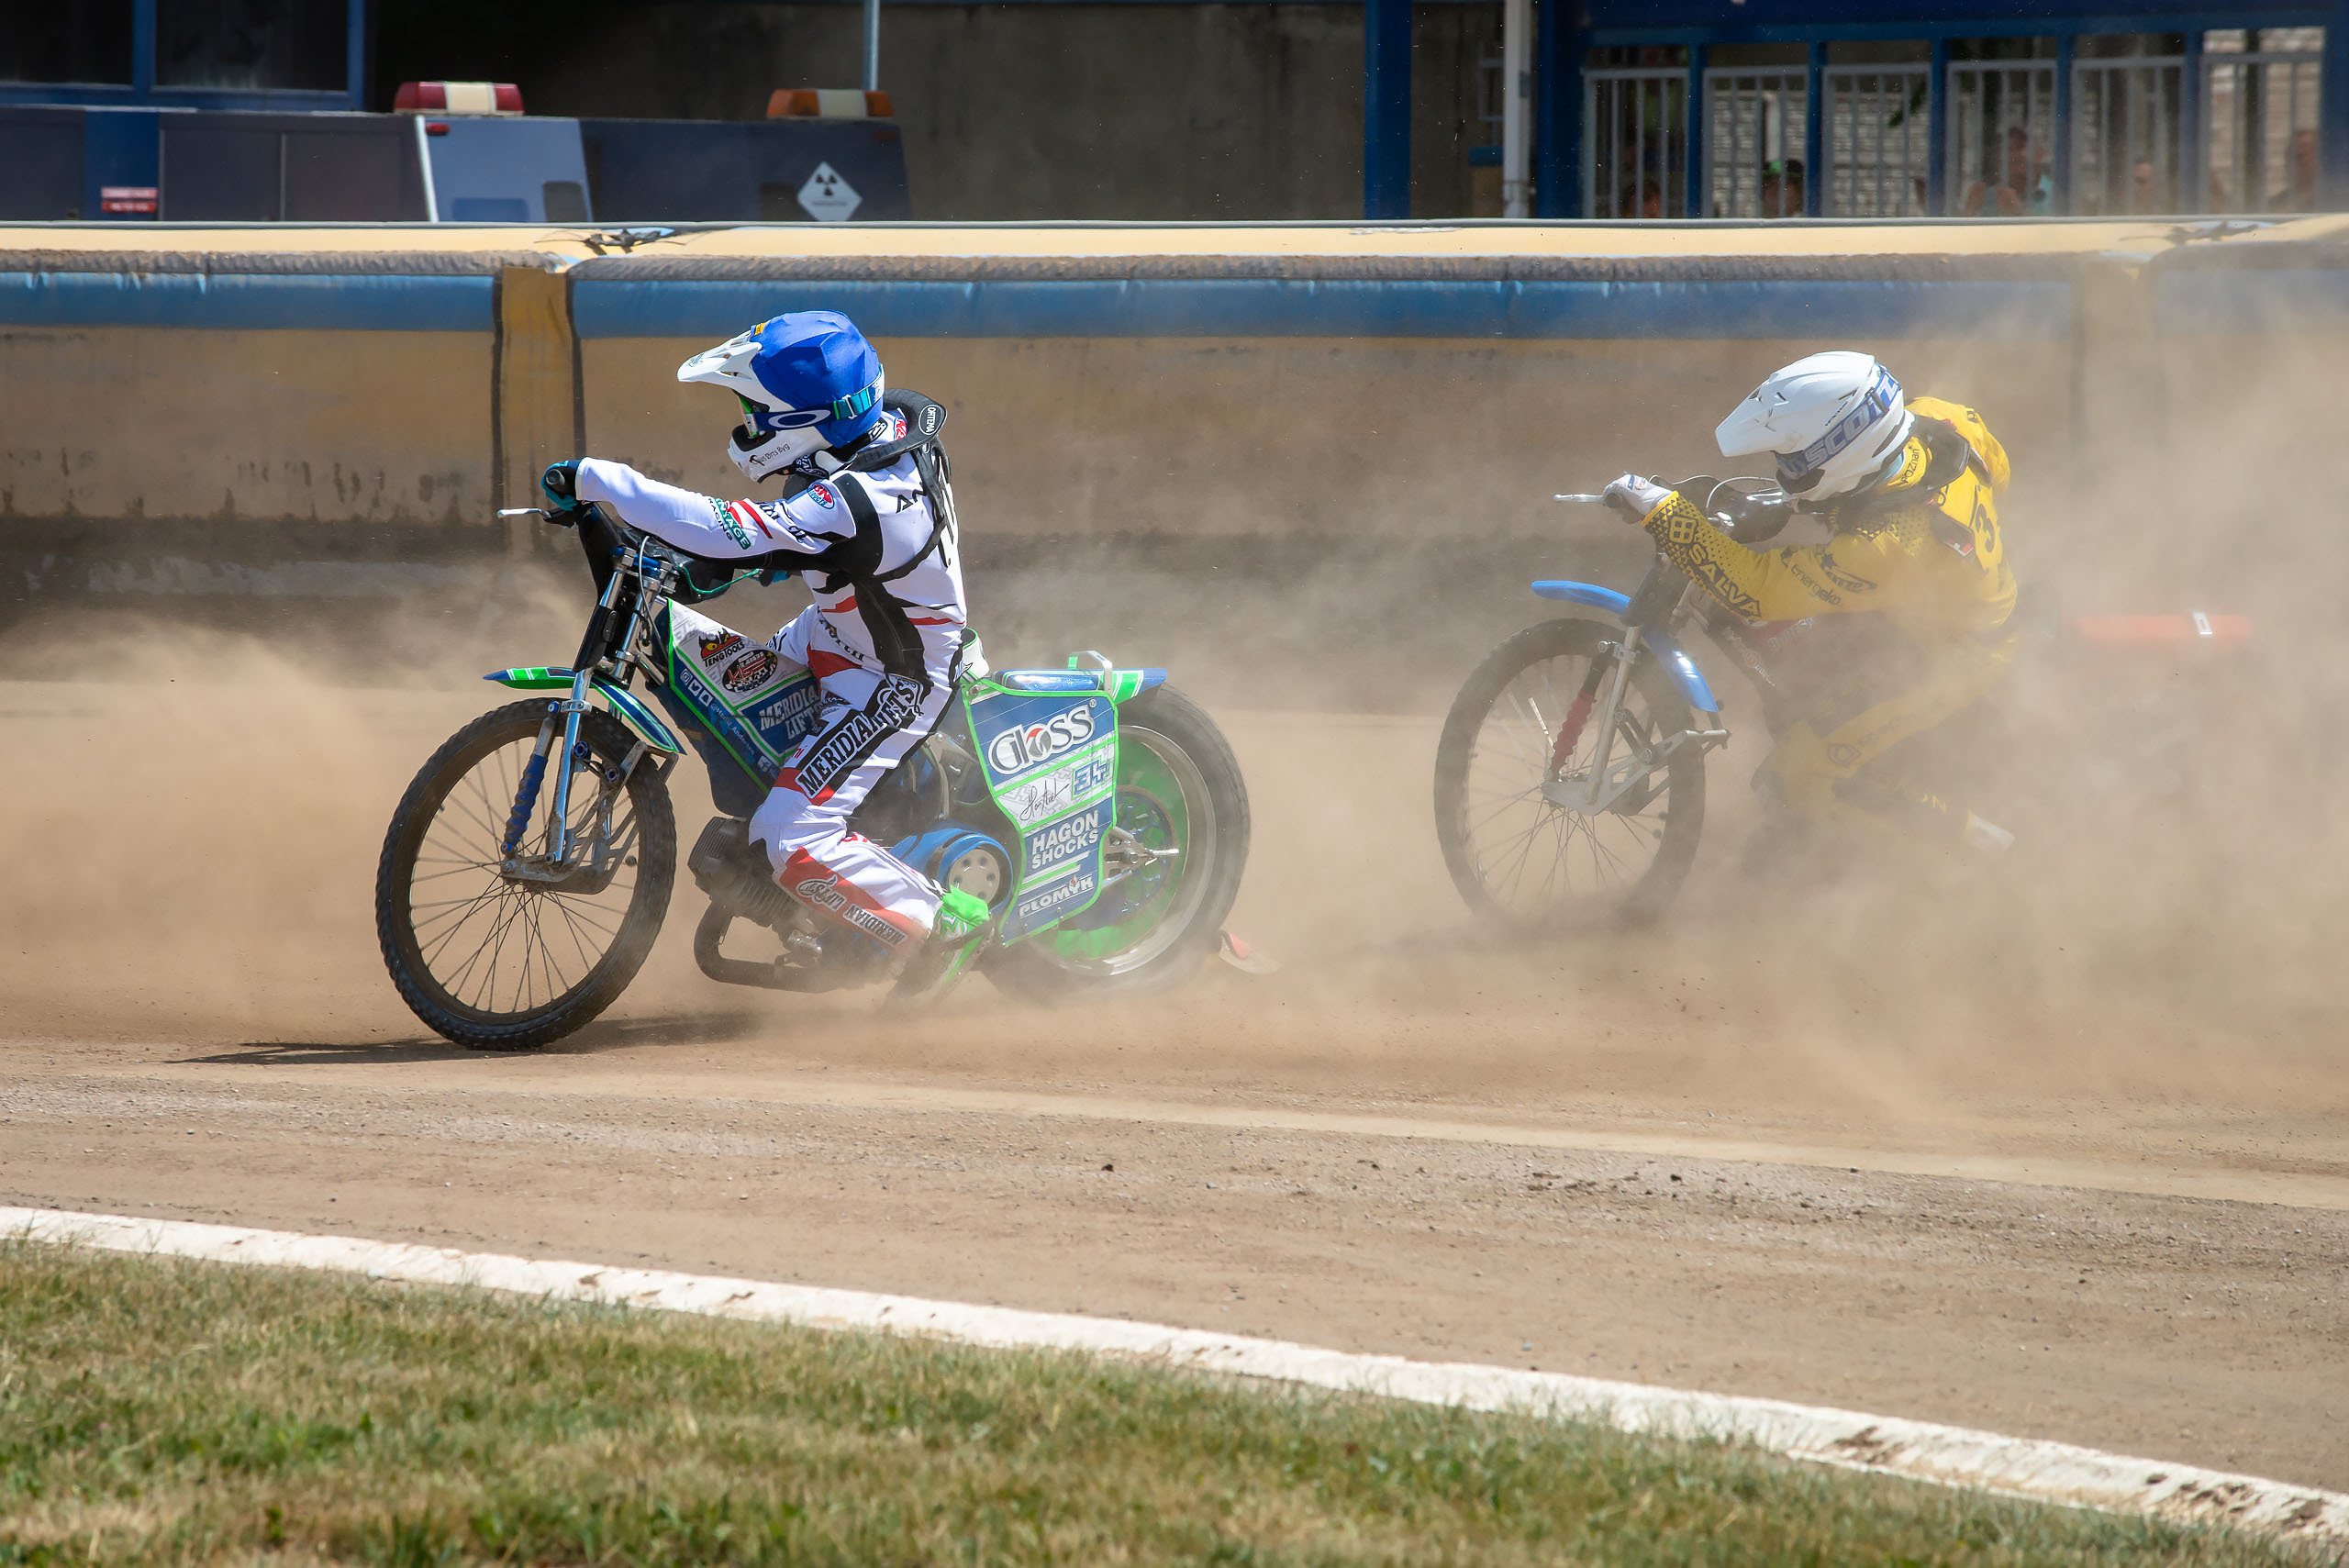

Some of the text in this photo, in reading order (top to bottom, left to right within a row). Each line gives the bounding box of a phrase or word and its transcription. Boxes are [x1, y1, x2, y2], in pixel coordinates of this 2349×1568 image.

[926, 406, 936, 433] ORTEMA
[777, 442, 791, 454] Byg
[1975, 503, 1996, 553] 3
[1687, 542, 1763, 617] SALVA
[759, 684, 817, 731] MERIDIA
[878, 679, 915, 726] IFTS
[990, 707, 1093, 773] Gloss
[1032, 809, 1098, 855] HAGON
[1032, 829, 1098, 869] SHOCKS
[1019, 875, 1094, 917] PLOMYK
[845, 905, 906, 946] MERIDIAN
